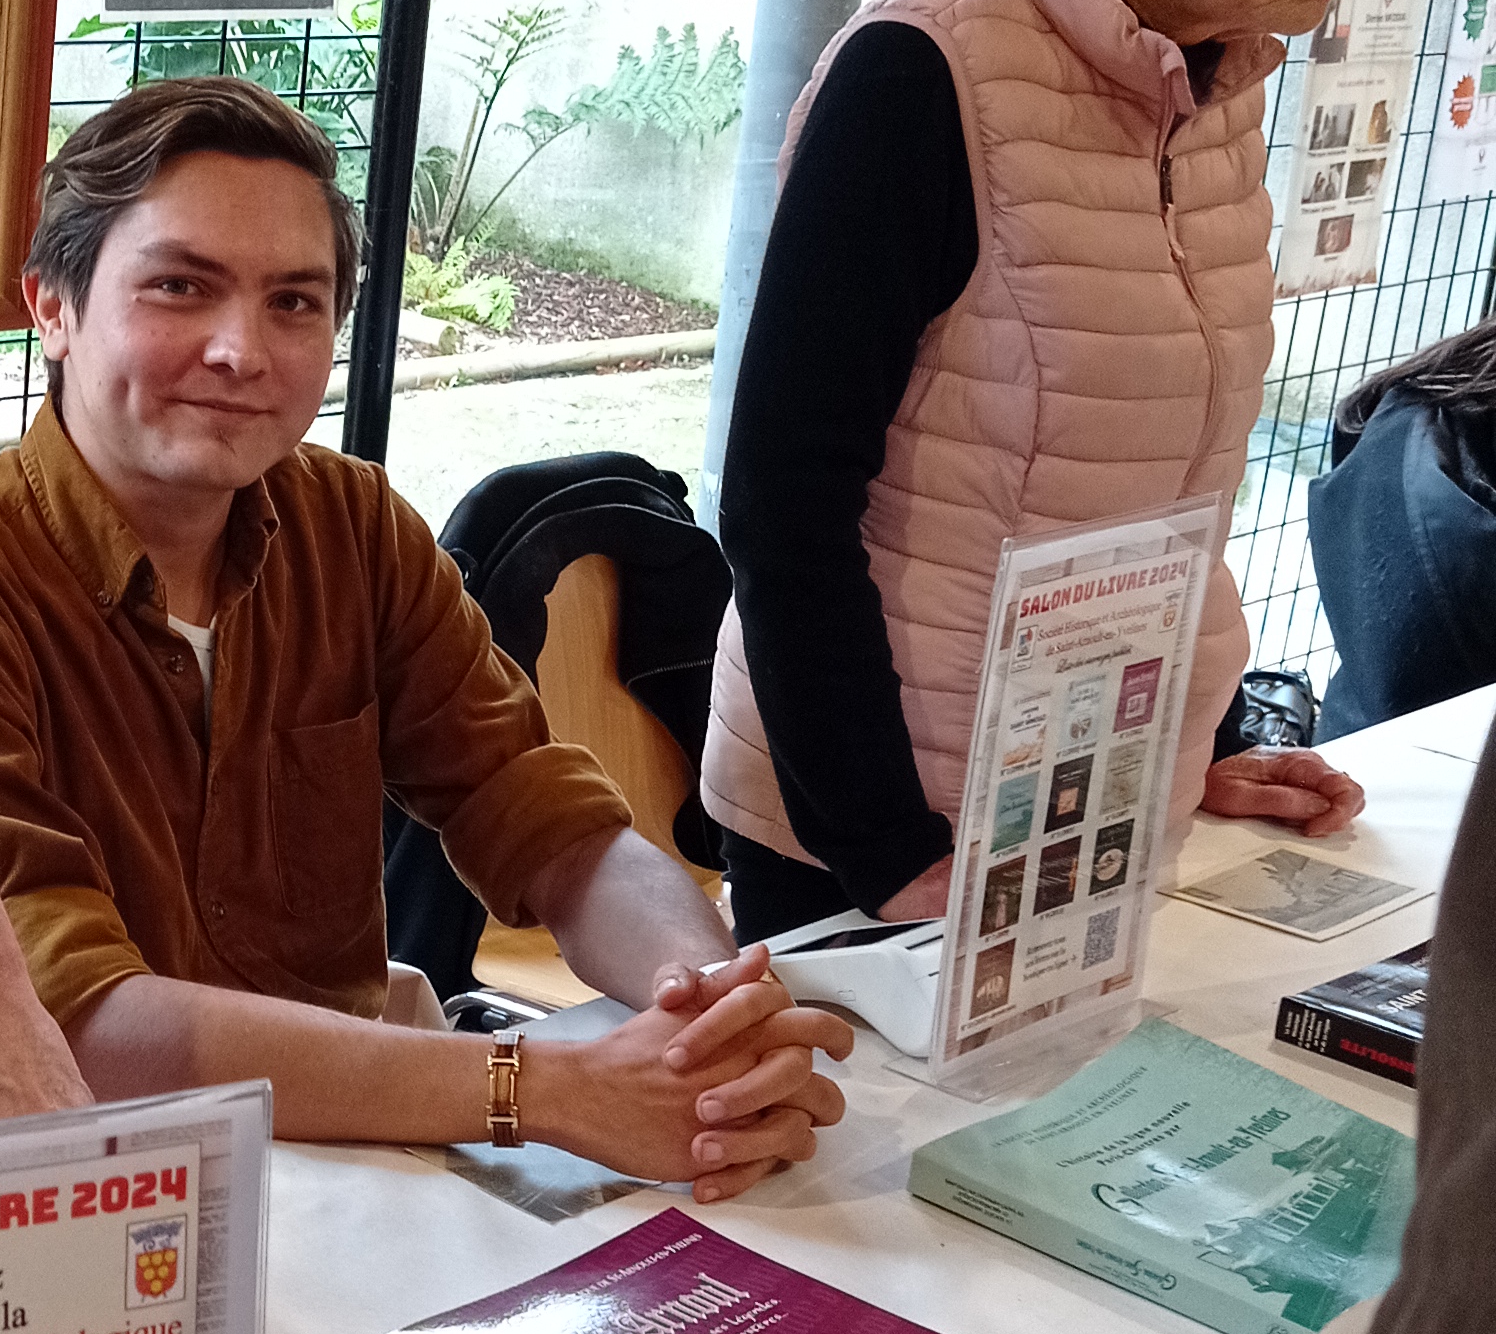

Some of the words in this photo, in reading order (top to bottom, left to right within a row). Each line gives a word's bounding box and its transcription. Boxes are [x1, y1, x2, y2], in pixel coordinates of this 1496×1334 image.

[1020, 587, 1072, 618] SALON
[1072, 580, 1096, 604] DU
[1097, 569, 1148, 598] LIVRE
[1148, 560, 1189, 585] 2024
[70, 1166, 188, 1221] 2024
[0, 1303, 29, 1331] la
